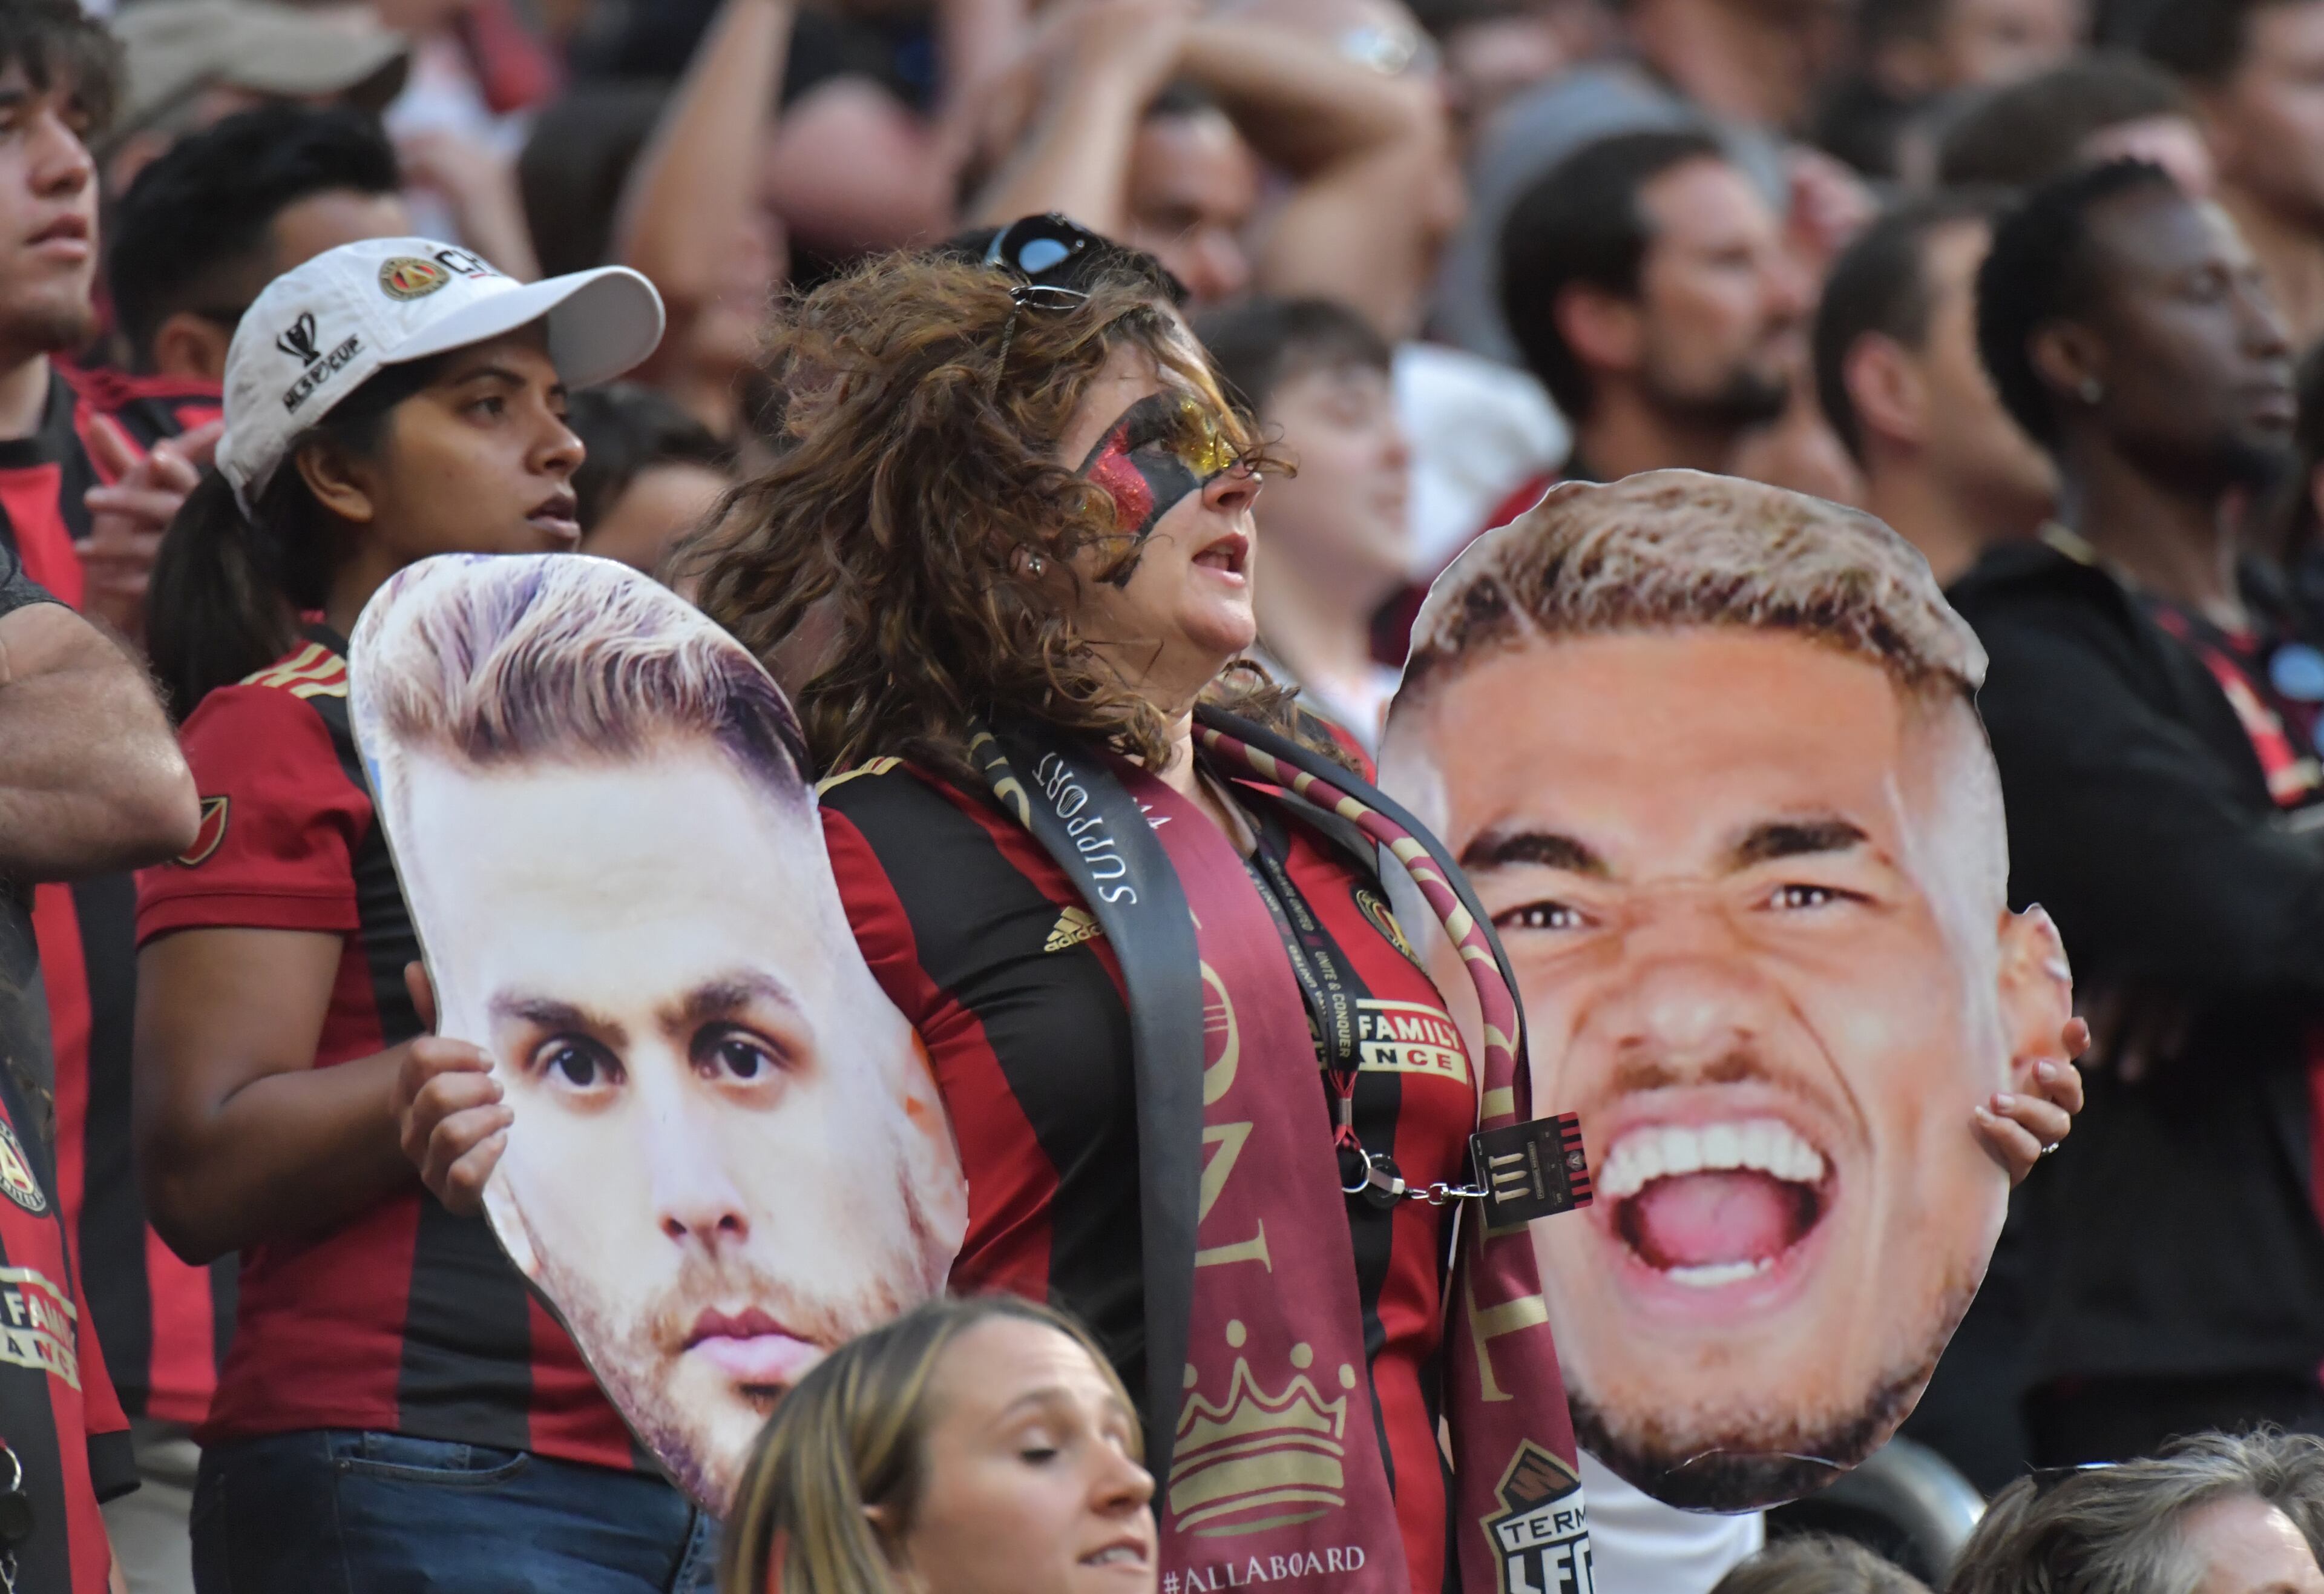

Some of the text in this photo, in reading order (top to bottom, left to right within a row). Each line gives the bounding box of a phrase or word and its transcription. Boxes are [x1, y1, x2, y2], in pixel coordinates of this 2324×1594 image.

[282, 334, 366, 415] MLS CUP
[1031, 751, 1137, 905] SUPPORT
[1315, 951, 1338, 982] UNITE
[1328, 982, 1342, 992] &
[1332, 993, 1352, 1058] CONQUER
[1358, 1015, 1460, 1050] FAMILY
[1360, 1047, 1453, 1072] NCE
[1163, 1546, 1366, 1594] #ALLABOARD
